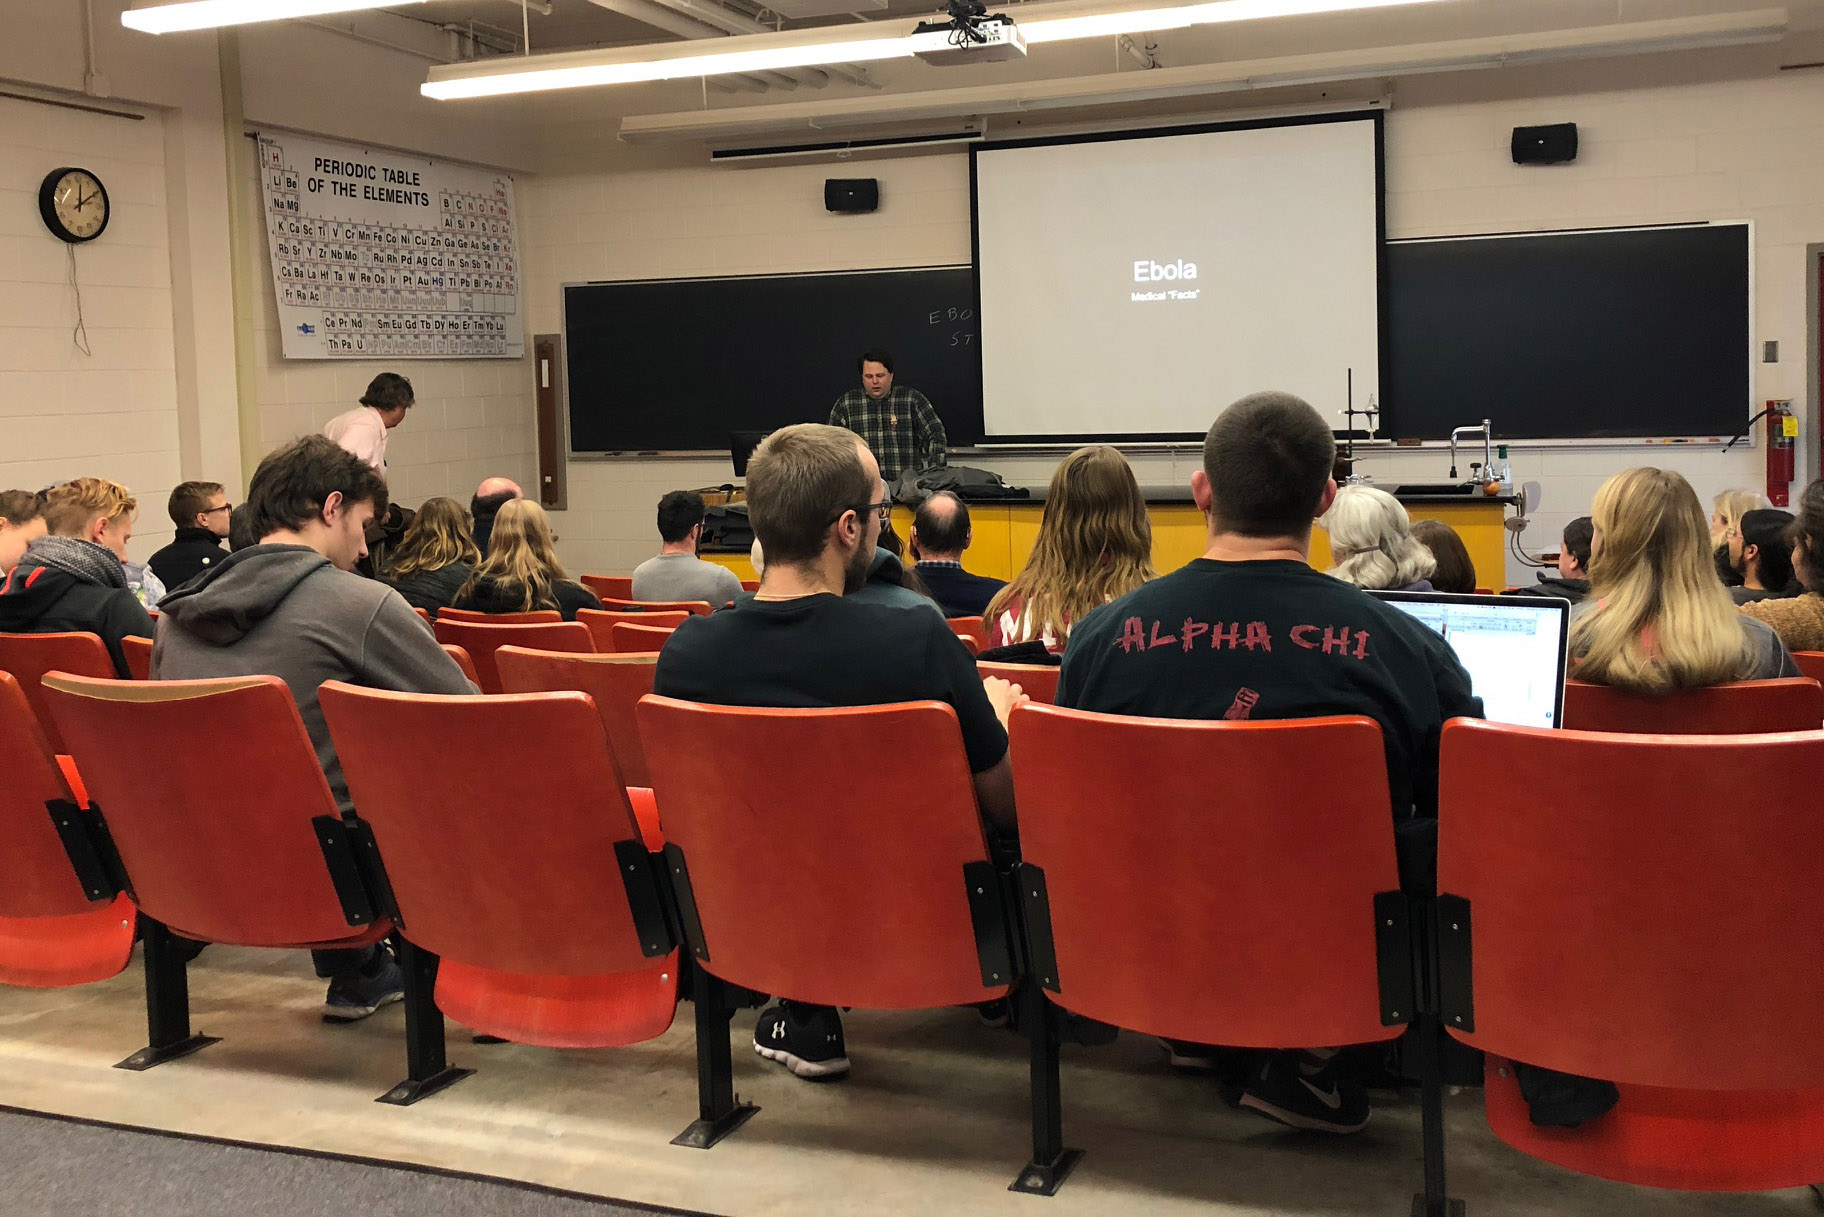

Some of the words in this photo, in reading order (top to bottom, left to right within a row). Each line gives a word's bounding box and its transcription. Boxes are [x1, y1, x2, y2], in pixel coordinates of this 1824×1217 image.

[272, 152, 279, 162] H
[314, 157, 376, 180] PERIODIC
[382, 168, 420, 186] TABLE
[274, 176, 281, 186] Li
[286, 178, 297, 188] Be
[308, 178, 324, 192] OF
[331, 181, 356, 198] THE
[364, 186, 430, 206] ELEMENTS
[274, 198, 284, 209] Na
[287, 200, 298, 212] Mg
[444, 198, 450, 208] B
[456, 200, 462, 210] C
[468, 202, 474, 211] N
[479, 204, 485, 212] O
[444, 218, 452, 228] Al
[458, 220, 465, 230] Si
[470, 221, 475, 229] P
[481, 222, 487, 232] S
[492, 224, 498, 232] Cl
[278, 221, 284, 232] K
[290, 222, 300, 234] Ca
[302, 224, 312, 236] Sc
[318, 226, 326, 236] Ti
[332, 228, 338, 238] V
[346, 229, 355, 240] Cr
[358, 230, 370, 240] Mn
[374, 232, 382, 242] Fe
[386, 234, 396, 244] Co
[401, 234, 410, 244] Ni
[414, 236, 426, 246] Cu
[430, 237, 441, 246] Zn
[444, 238, 455, 248] Ga
[458, 239, 468, 248] Ge
[470, 240, 480, 250] As
[482, 242, 490, 251] Se
[493, 242, 500, 252] Br
[278, 244, 288, 254] Rb
[292, 246, 300, 256] Sr
[306, 247, 312, 256] Y
[318, 248, 327, 258] Zr
[331, 250, 342, 260] Nb
[344, 250, 357, 260] Mo
[374, 252, 384, 263] Ru
[387, 254, 398, 264] Rh
[401, 254, 412, 264] Pd
[416, 256, 428, 267] Ag
[431, 256, 442, 266] Cd
[447, 258, 454, 267] In
[460, 259, 469, 268] Sn
[472, 260, 480, 269] Sb
[484, 260, 491, 270] Te
[1134, 258, 1197, 282] Ebola
[282, 266, 292, 277] Cs
[294, 268, 304, 278] Ba
[307, 269, 316, 280] La
[320, 270, 328, 280] Hf
[334, 271, 343, 281] Ta
[348, 272, 356, 282] W
[361, 273, 370, 283] Re
[374, 274, 385, 284] Os
[390, 274, 396, 284] Ir
[403, 276, 412, 285] Pt
[418, 276, 428, 286] Au
[432, 276, 444, 287] Hg
[460, 278, 470, 288] Pb
[474, 279, 480, 288] Bi
[485, 280, 492, 289] Po
[506, 282, 513, 290] Rn
[286, 289, 292, 299] Fr
[296, 290, 306, 300] Ra
[310, 290, 319, 301] Ac
[1131, 291, 1166, 302] Medical
[325, 318, 335, 328] Ce
[338, 318, 347, 328] Pr
[352, 318, 362, 328] Nd
[378, 319, 390, 329] Sm
[392, 320, 402, 329] Eu
[405, 320, 416, 330] Gd
[420, 320, 430, 330] Tb
[434, 321, 444, 330] Dy
[448, 321, 459, 330] Ho
[462, 321, 470, 330] Er
[474, 321, 484, 330] Tm
[486, 322, 494, 330] Yb
[496, 322, 504, 330] Lu
[329, 340, 338, 350] Th
[342, 340, 352, 350] Pa
[357, 340, 362, 350] U
[1112, 616, 1272, 653] ALPHA
[1289, 624, 1370, 660] CHI
